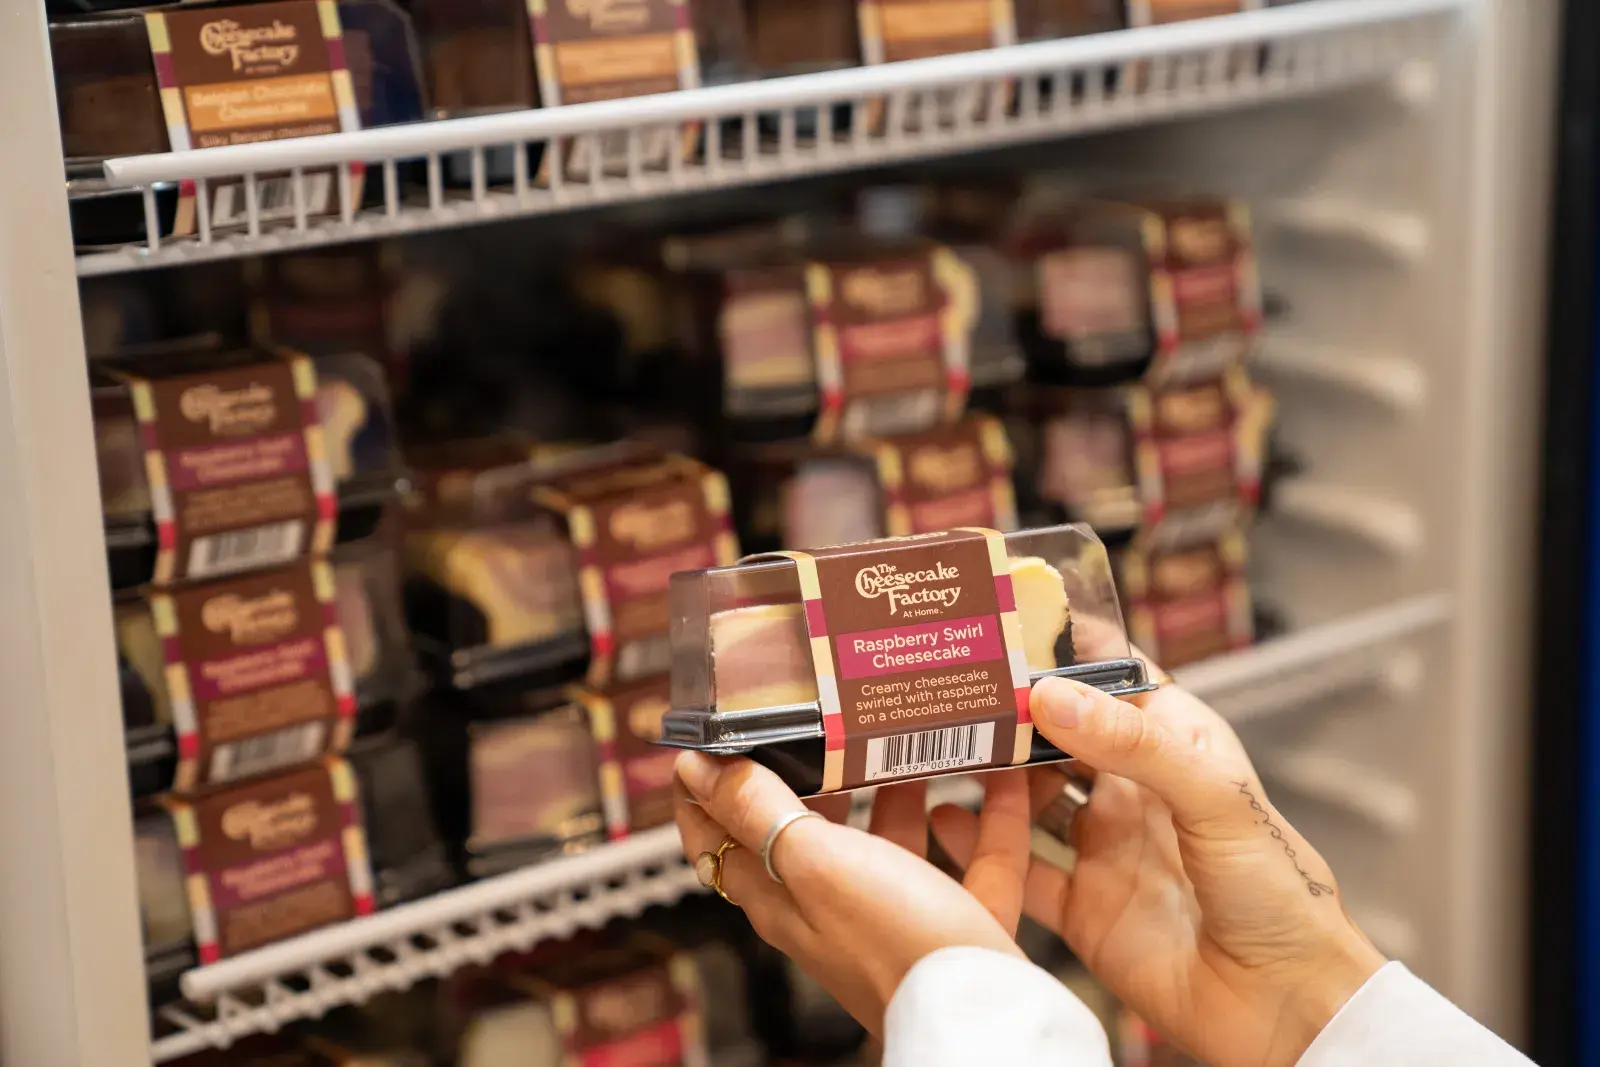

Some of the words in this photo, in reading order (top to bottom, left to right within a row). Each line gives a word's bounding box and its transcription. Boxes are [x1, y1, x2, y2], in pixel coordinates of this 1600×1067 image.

[855, 561, 960, 598] Cheesecake
[878, 564, 897, 575] The
[878, 585, 962, 616] Factory
[902, 611, 913, 619] At
[853, 631, 938, 654] Raspberry
[943, 623, 984, 642] Swirl
[872, 645, 971, 669] Cheesecake
[856, 694, 902, 711] swirled
[905, 691, 934, 704] with
[937, 683, 998, 701] raspberry
[861, 681, 911, 697] Creamy
[915, 670, 989, 689] cheesecake
[858, 714, 875, 724] on
[878, 712, 887, 722] a
[890, 702, 953, 720] chocolate
[956, 695, 1001, 710] crumb.
[892, 763, 926, 776] 85397
[931, 758, 964, 770] 00318
